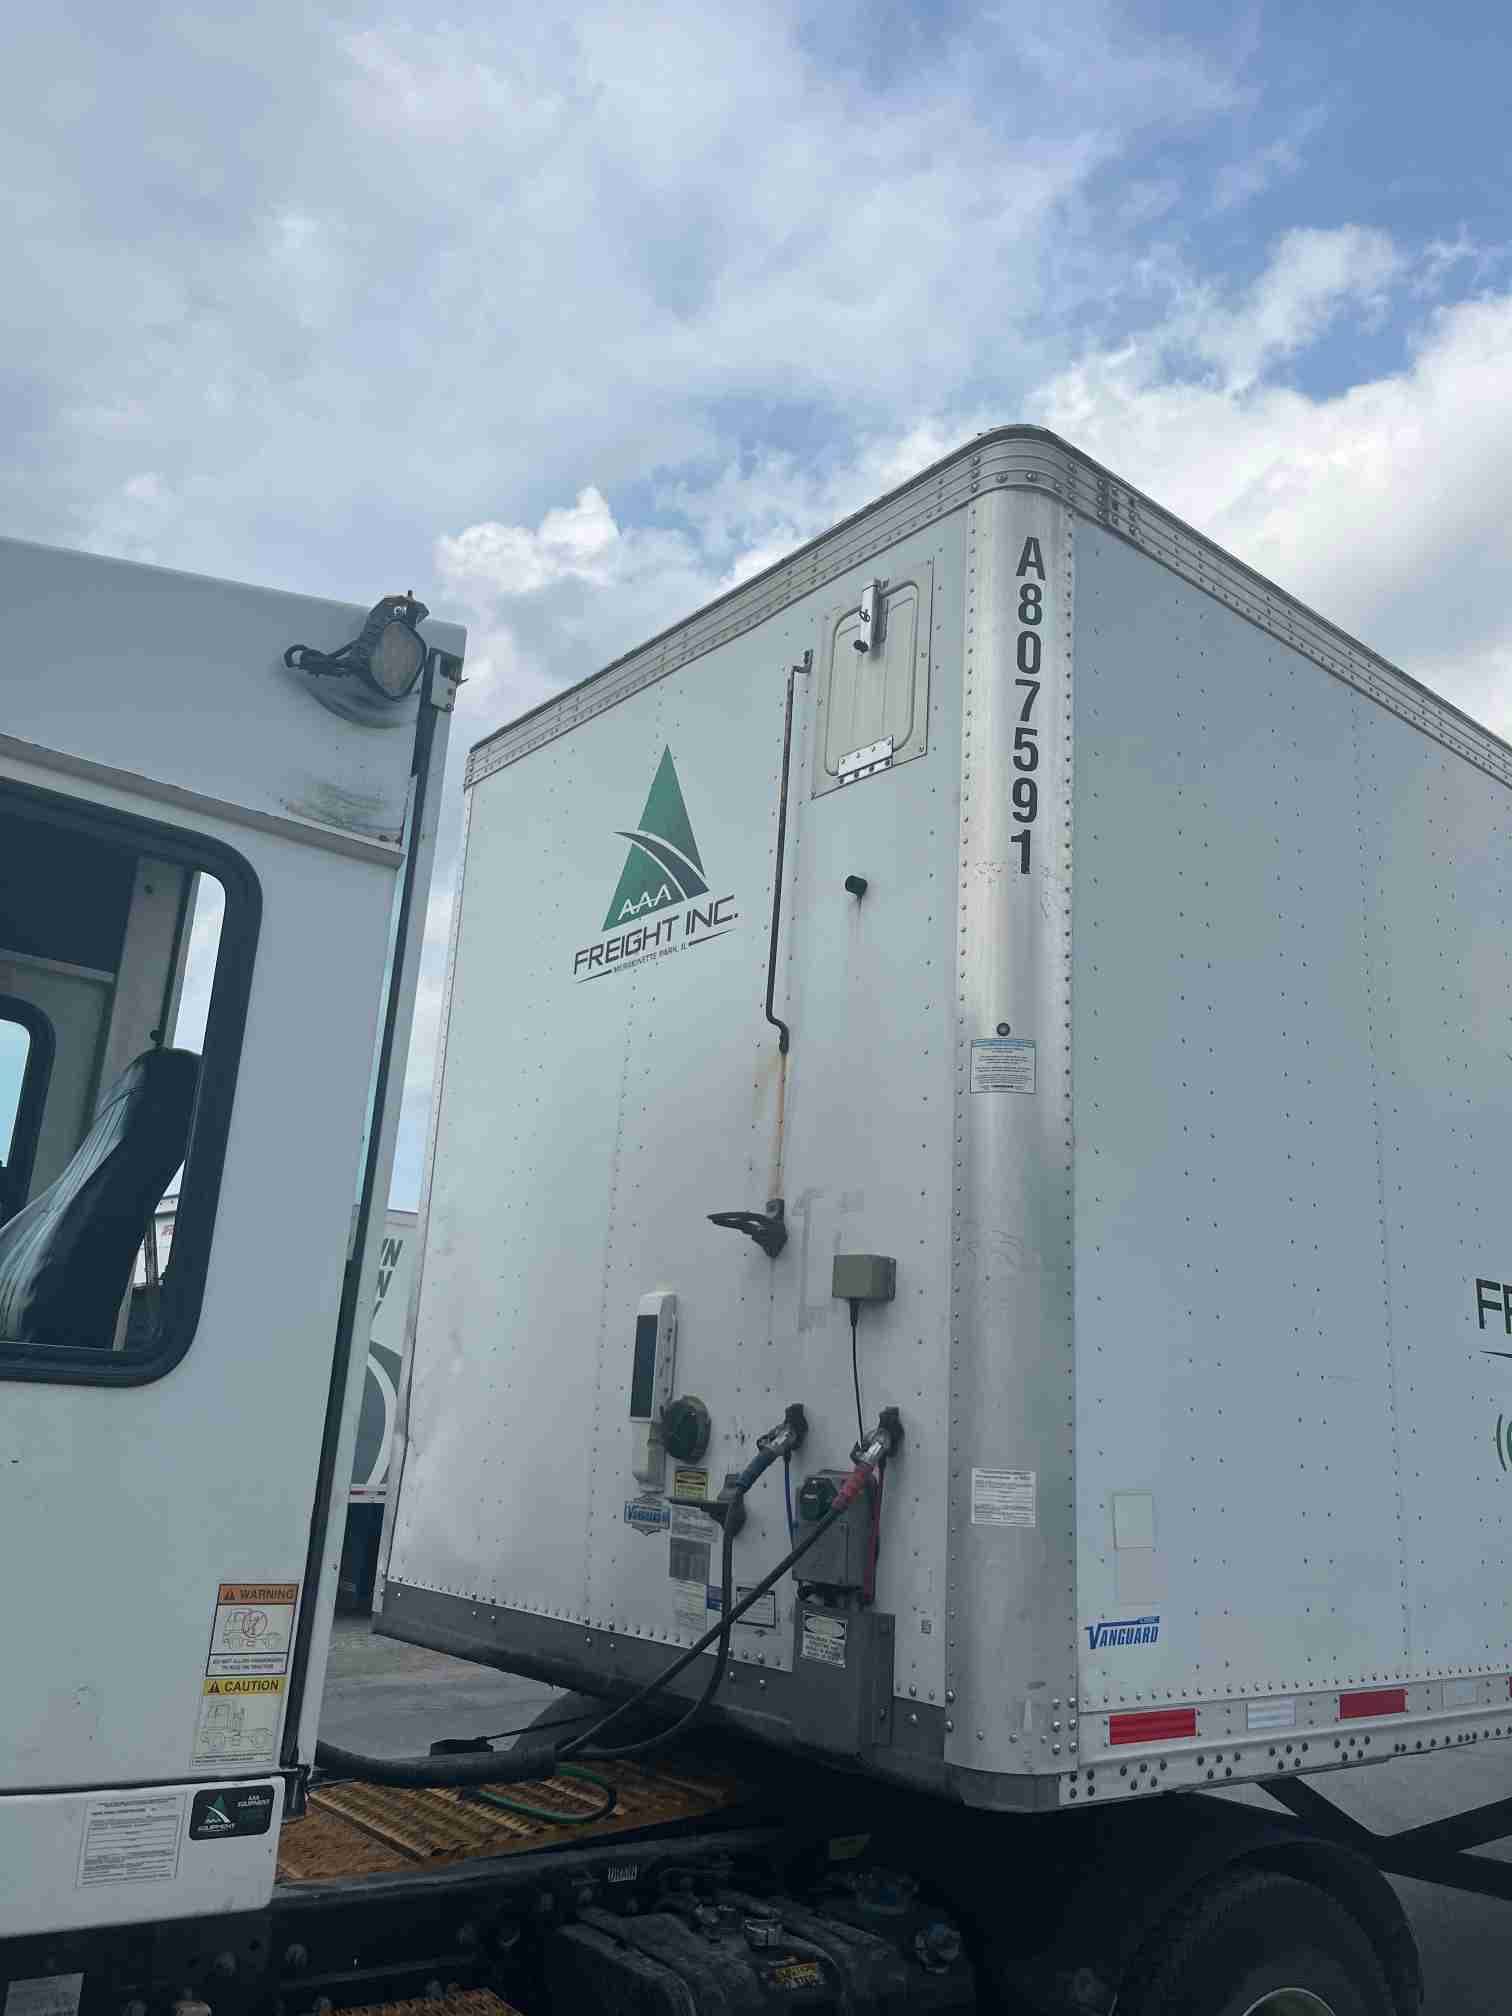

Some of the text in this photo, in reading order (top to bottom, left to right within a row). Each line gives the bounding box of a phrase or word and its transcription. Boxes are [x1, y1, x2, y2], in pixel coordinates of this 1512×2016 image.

[1010, 536, 1046, 875] A807591
[617, 884, 672, 920] AAA
[573, 894, 739, 975] FREIGHT INC.
[240, 1588, 294, 1600] WARNING
[1084, 1620, 1160, 1650] VANGUARD
[224, 1680, 279, 1692] CAUTION
